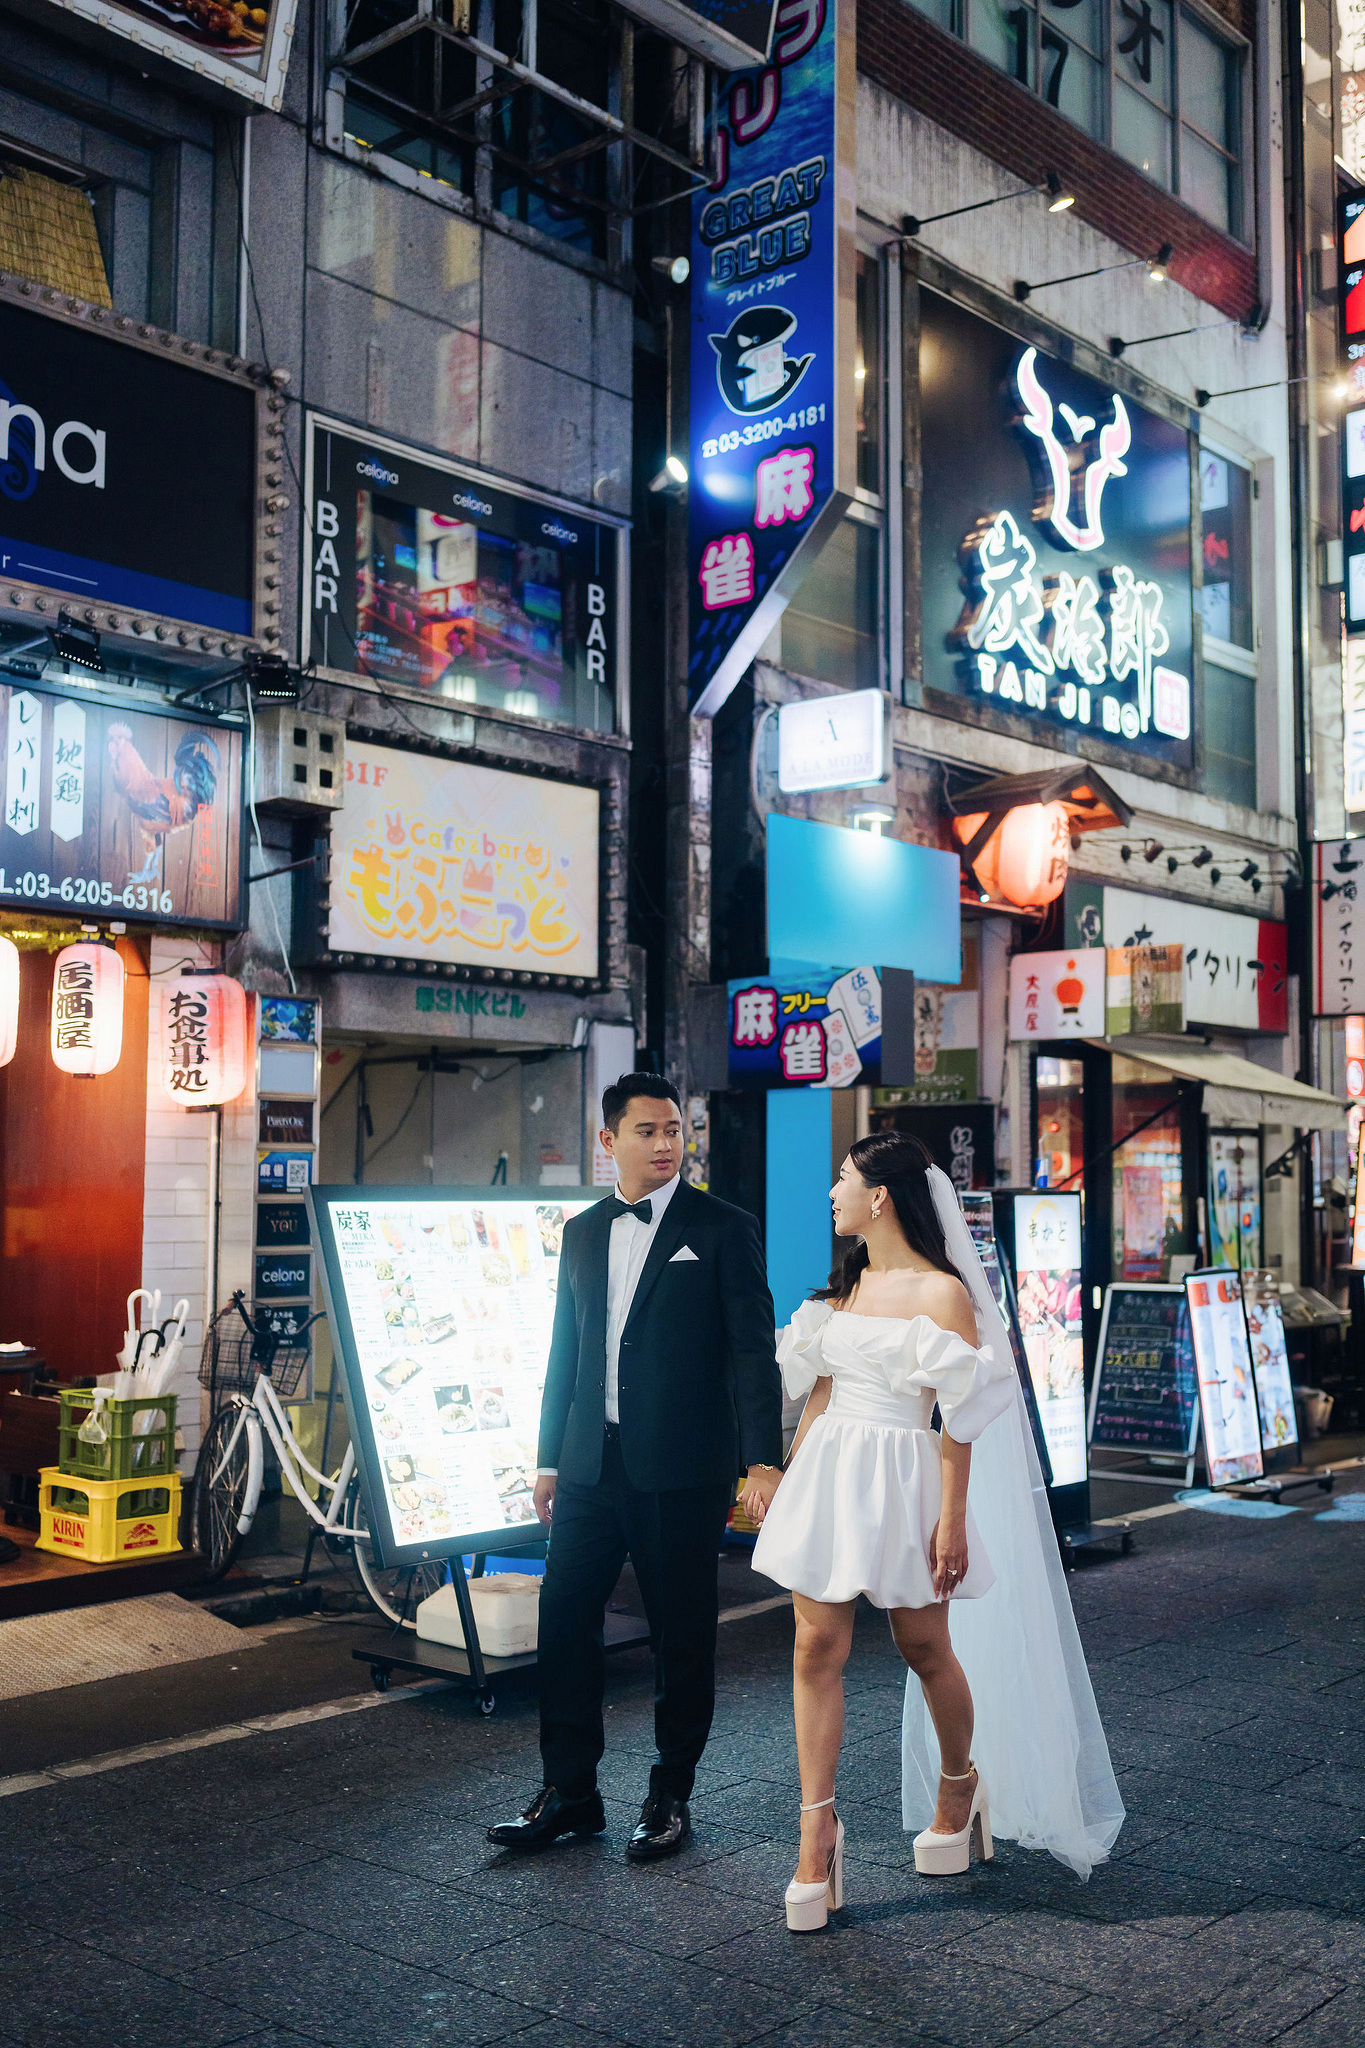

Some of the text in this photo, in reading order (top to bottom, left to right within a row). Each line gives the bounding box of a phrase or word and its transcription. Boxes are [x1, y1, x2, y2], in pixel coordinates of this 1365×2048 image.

[703, 160, 823, 240] GREAT
[713, 217, 808, 284] BLUE
[726, 272, 797, 305] グレイトブルー
[719, 403, 826, 454] 03-3200-4181
[356, 460, 399, 485] celona
[453, 493, 493, 516] celona
[315, 500, 340, 613] BAR
[541, 522, 578, 543] celona
[699, 447, 814, 611] 麻雀
[586, 583, 607, 683] BAR
[978, 653, 1046, 710] TAN
[1058, 682, 1091, 724] JI
[1103, 695, 1140, 739] RO
[54, 738, 83, 805] 地鶏
[56, 961, 94, 1049] 居酒屋
[735, 988, 824, 1079] 麻雀
[782, 992, 827, 1014] フリー
[168, 990, 209, 1093] お食事処
[336, 1210, 371, 1231] 炭家
[262, 1268, 305, 1283] celona
[53, 1518, 85, 1540] KIRIN
